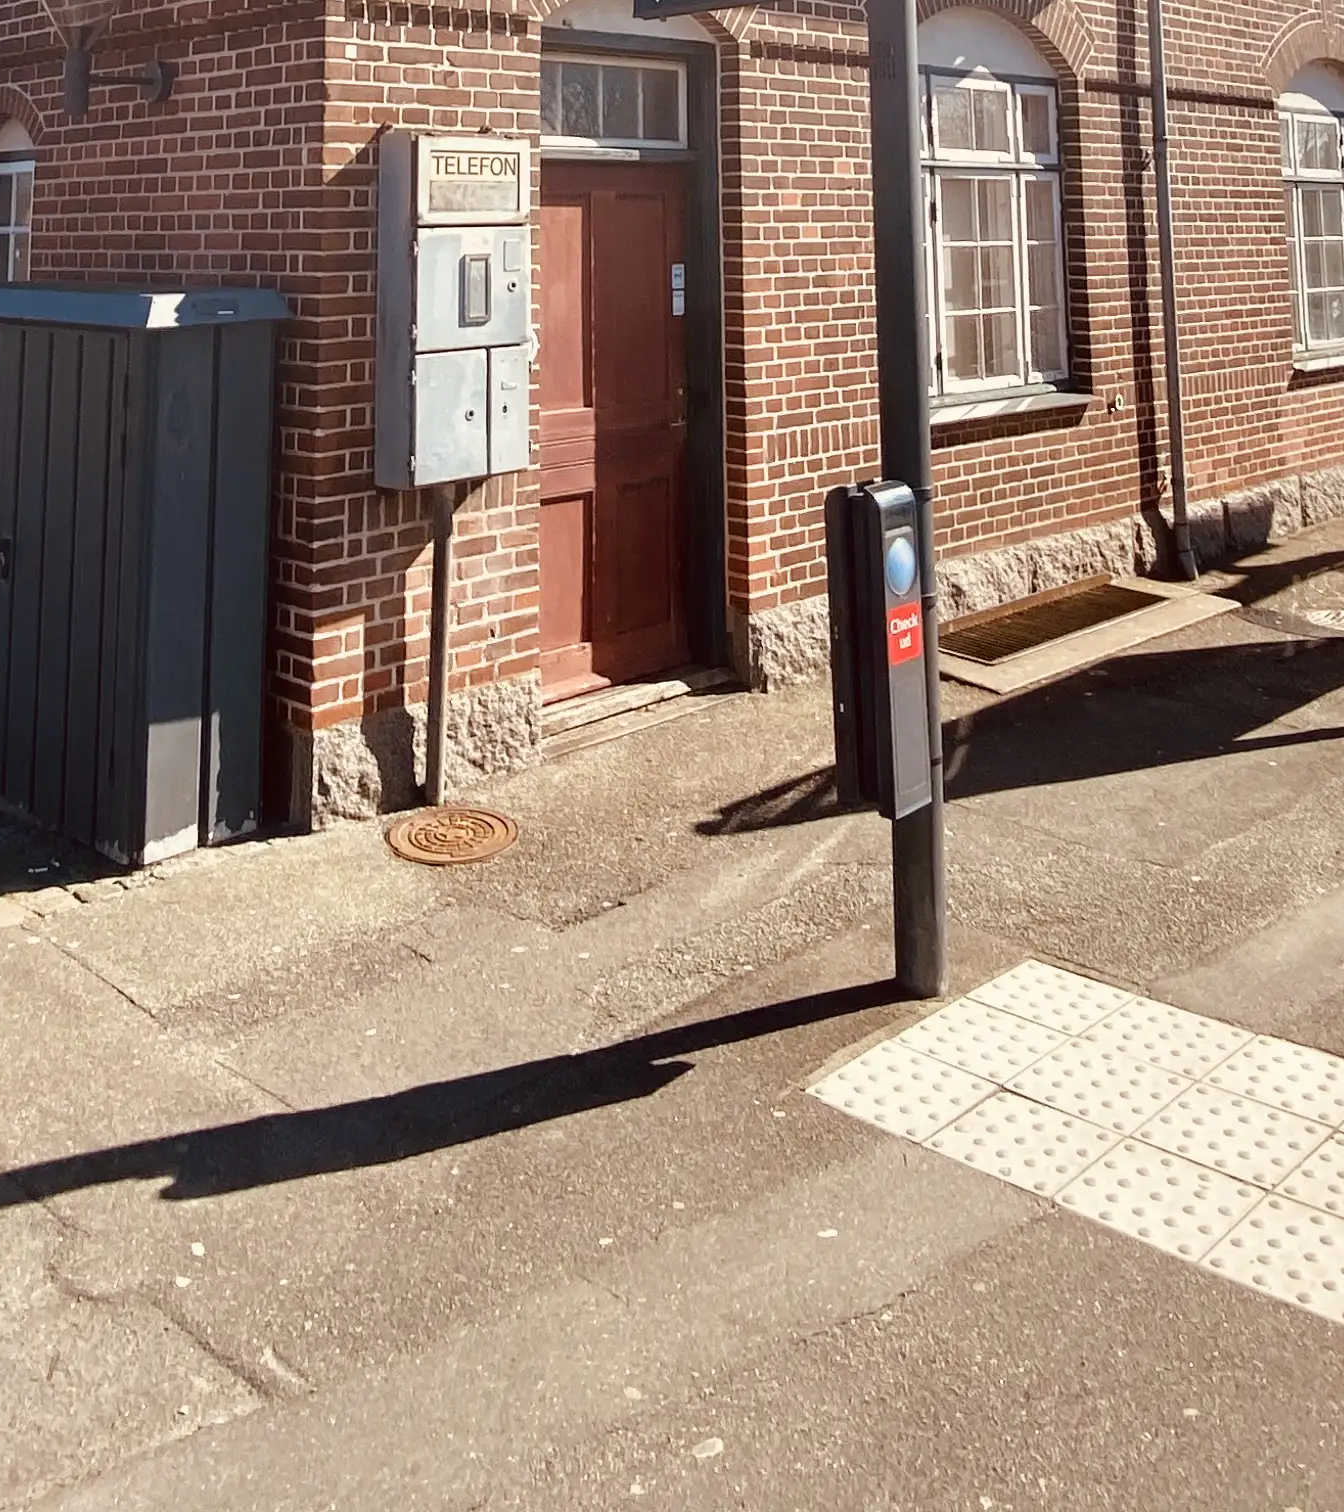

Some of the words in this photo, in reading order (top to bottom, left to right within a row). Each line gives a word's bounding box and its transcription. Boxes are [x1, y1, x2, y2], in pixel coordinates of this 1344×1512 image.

[431, 155, 516, 176] TELEFON
[889, 612, 919, 635] Check
[898, 631, 912, 650] ud
